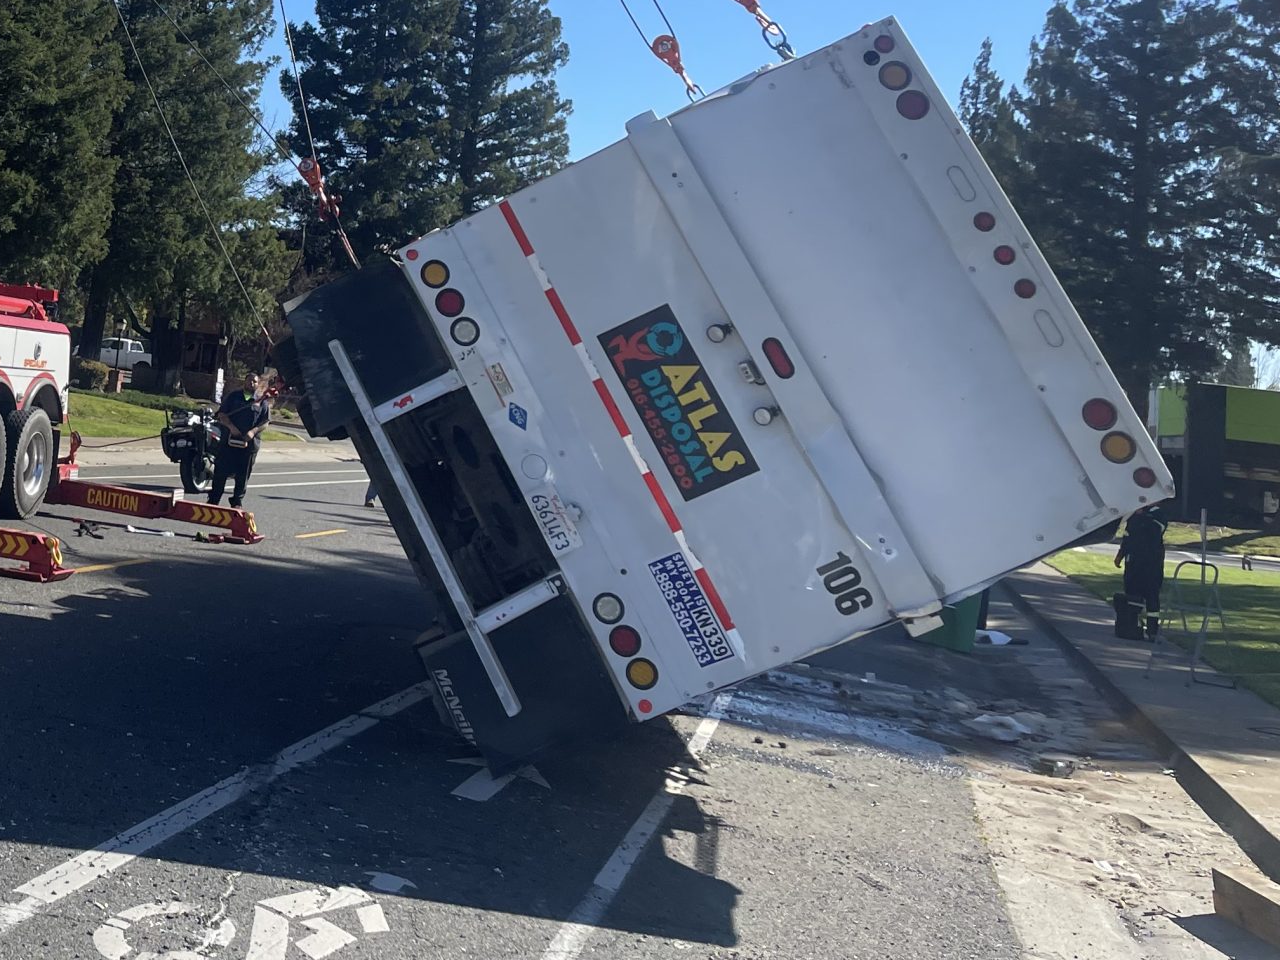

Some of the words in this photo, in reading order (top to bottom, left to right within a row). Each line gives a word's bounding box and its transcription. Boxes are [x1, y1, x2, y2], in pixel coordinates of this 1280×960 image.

[641, 368, 714, 483] DISPOSAL
[660, 365, 746, 472] ATLAS
[87, 488, 139, 512] CAUTION
[531, 494, 570, 551] 63614F3
[664, 560, 679, 576] MY
[675, 581, 694, 609] GOAL
[672, 554, 698, 591] SAFETY
[694, 594, 705, 606] IS
[816, 551, 873, 616] 106
[650, 562, 711, 664] 1-888-550-7233
[693, 607, 728, 657] KN339
